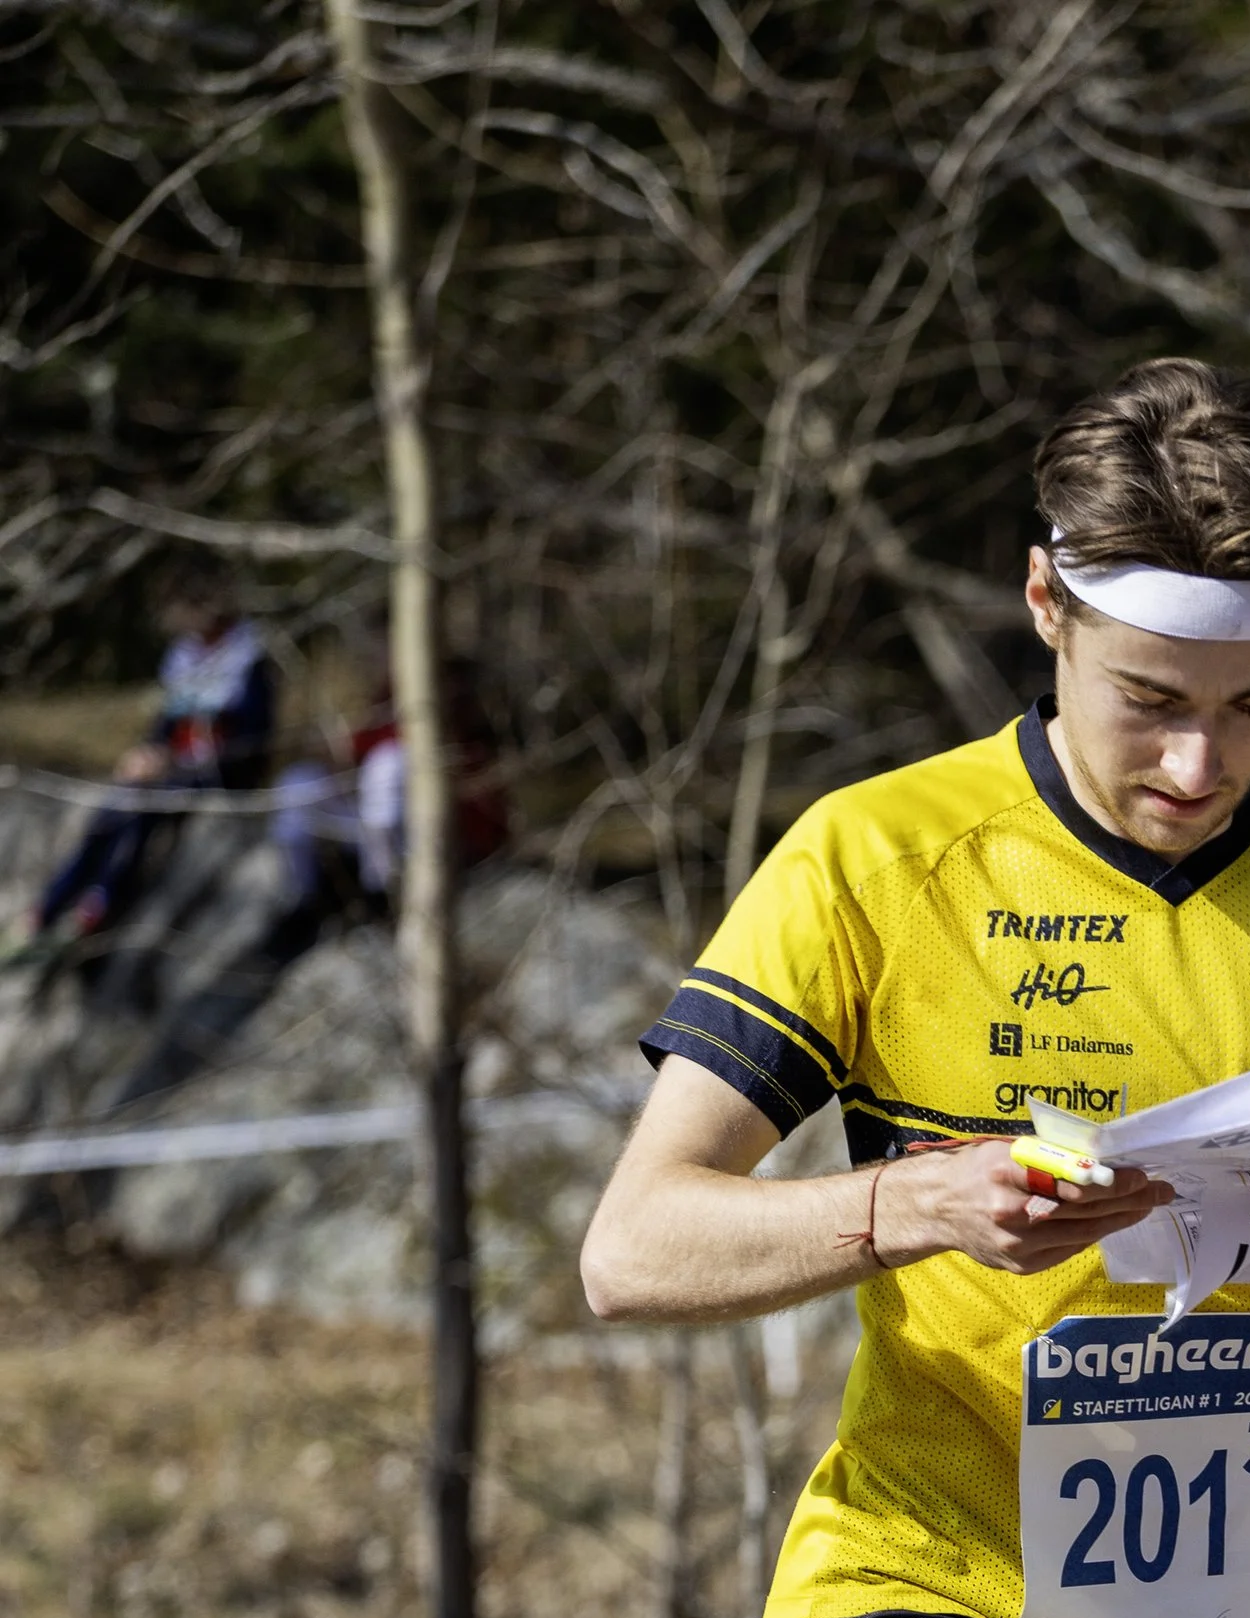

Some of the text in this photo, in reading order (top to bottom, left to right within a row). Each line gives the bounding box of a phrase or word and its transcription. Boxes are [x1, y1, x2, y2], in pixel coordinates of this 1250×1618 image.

[987, 910, 1130, 943] TRIMTEX
[1030, 1034, 1134, 1056] LF Dalarnas
[995, 1080, 1119, 1114] granitor
[1072, 1394, 1196, 1417] STAFETTLIGAN
[1059, 1448, 1228, 1589] 201
